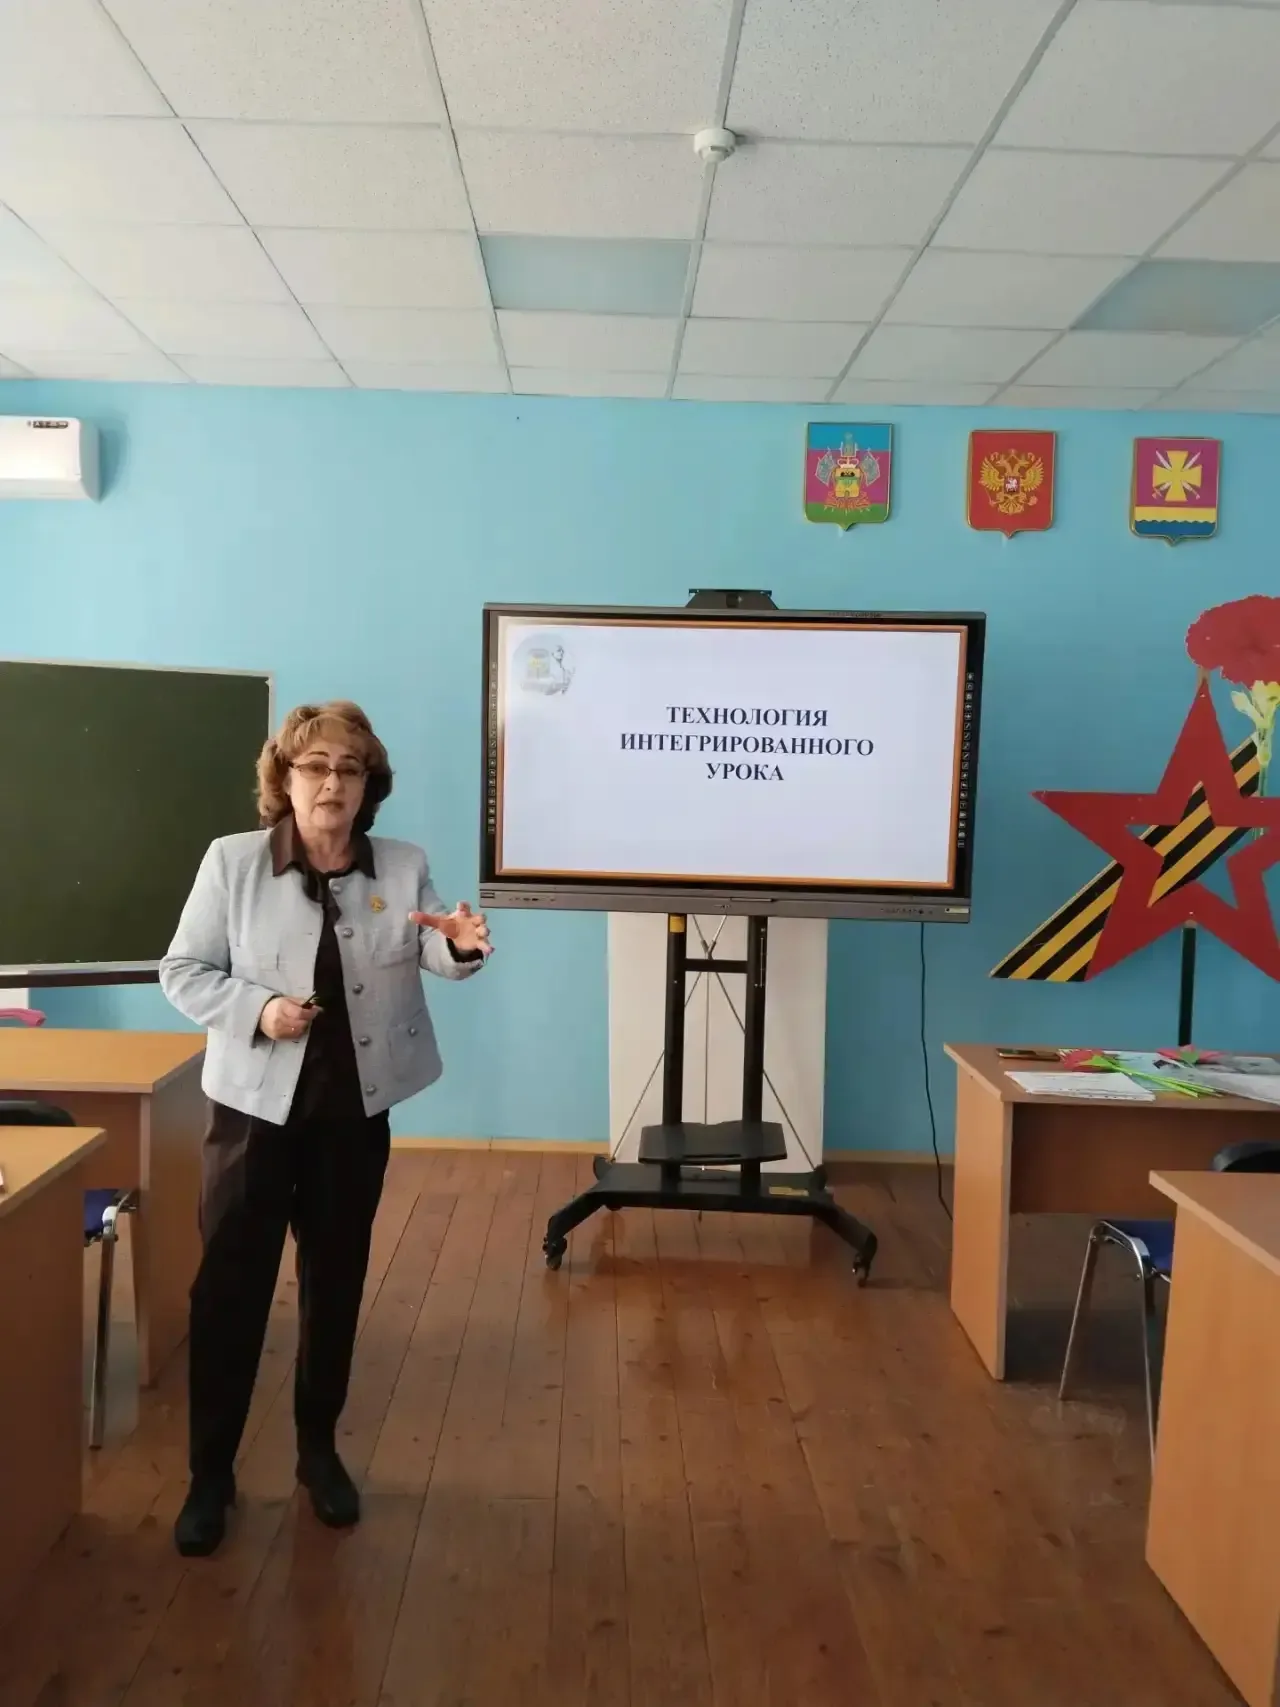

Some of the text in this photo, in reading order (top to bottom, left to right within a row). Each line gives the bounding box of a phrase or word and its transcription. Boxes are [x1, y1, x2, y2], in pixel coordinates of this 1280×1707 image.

[666, 706, 828, 726] ТЕХНОЛОГИЯ
[620, 733, 874, 756] ИНТЕГРИРОВАННОГО
[706, 762, 784, 781] УРОКА
